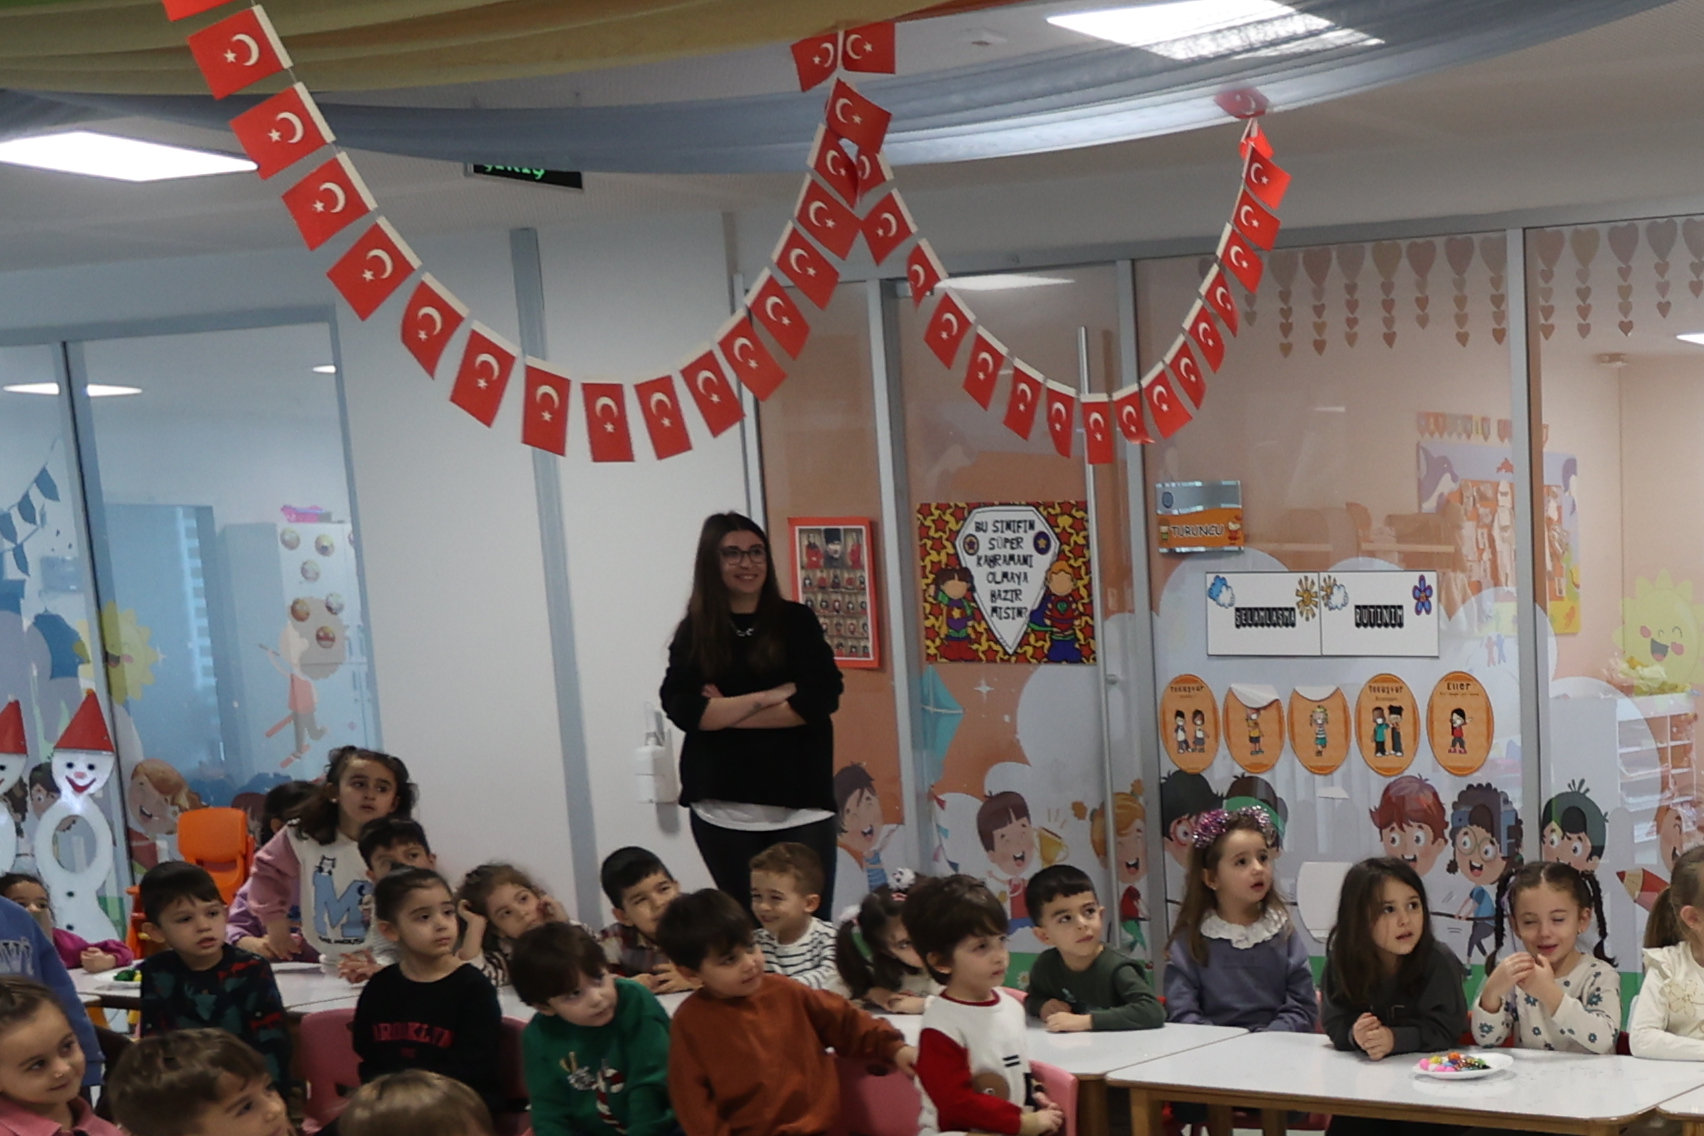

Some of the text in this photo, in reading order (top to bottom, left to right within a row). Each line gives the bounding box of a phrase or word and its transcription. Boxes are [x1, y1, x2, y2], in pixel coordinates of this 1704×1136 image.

[974, 519, 1036, 534] BU SINIFIN
[1171, 524, 1225, 538] TURUNCU
[986, 571, 1029, 586] OLMAYA
[990, 588, 1023, 603] HAZIR
